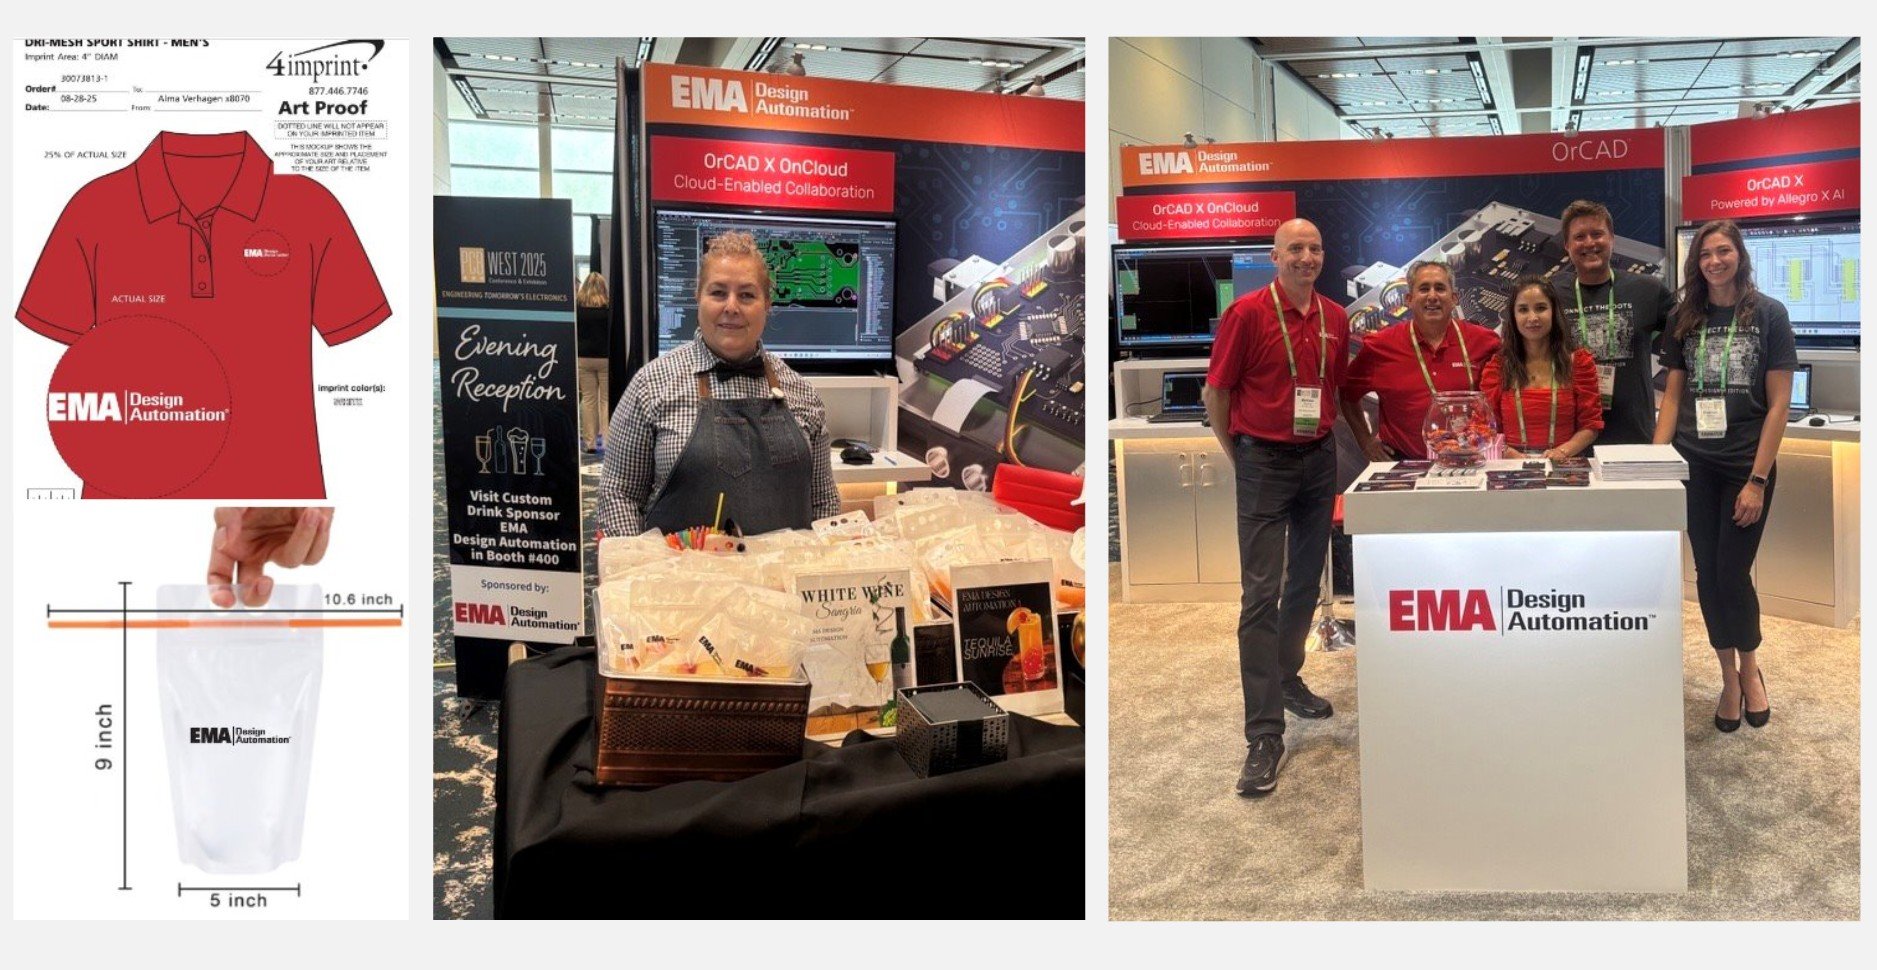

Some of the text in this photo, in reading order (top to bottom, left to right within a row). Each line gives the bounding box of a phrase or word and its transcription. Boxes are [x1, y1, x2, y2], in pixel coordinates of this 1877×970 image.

[25, 39, 83, 47] DRI-MESH
[87, 39, 122, 47] SPORT
[128, 39, 160, 47] SHIRT
[171, 39, 209, 47] MEN'S
[25, 52, 54, 62] Imprint
[58, 52, 79, 61] Area:
[94, 52, 118, 61] DIAM
[25, 85, 56, 93] Order#
[309, 86, 368, 95] 877.446.7746
[671, 75, 809, 113] EMA Design
[182, 95, 223, 104] Verhagen
[278, 100, 368, 115] Art Proof
[1552, 139, 1629, 162] OrCAD
[704, 153, 848, 177] OrCAD X OnCloud
[1139, 150, 1238, 175] EMA Design
[674, 175, 875, 200] Cloud-Enabled Collaboration
[1747, 174, 1804, 191] OrCAD X
[1710, 189, 1844, 211] Powered by Allegro X AI
[1152, 202, 1259, 215] OrCAD X OnCloud
[1132, 216, 1281, 231] Cloud-Enabled Collaboration
[244, 249, 262, 257] EMA
[488, 251, 518, 275] WEST
[520, 252, 547, 277] 2025
[111, 295, 166, 303] ACTUAL SIZE
[442, 291, 568, 302] ENGINEERING TOMORROW'S ELECTRONICS
[455, 324, 558, 379] Evening
[451, 367, 566, 413] Reception
[48, 392, 183, 421] EMA Design
[470, 490, 552, 506] Visit Custom
[467, 505, 560, 523] Drink Sponsor
[500, 522, 528, 534] EMA
[453, 534, 577, 552] Design Automation
[471, 549, 560, 565] in Booth #400
[481, 579, 549, 593] Sponsored by:
[802, 584, 904, 603] WHITE WINE
[324, 594, 393, 605] 10.6 inch
[454, 602, 548, 626] EMA Design
[1389, 588, 1585, 631] EMA Design
[646, 635, 665, 643] EMA
[699, 636, 714, 655] EMA
[964, 635, 1012, 650] TEQUILA
[965, 645, 1012, 660] SUNRISE
[735, 659, 754, 673] EMA
[95, 704, 112, 770] 9 inch
[190, 727, 266, 744] EMA Design
[210, 894, 267, 907] 5 inch
